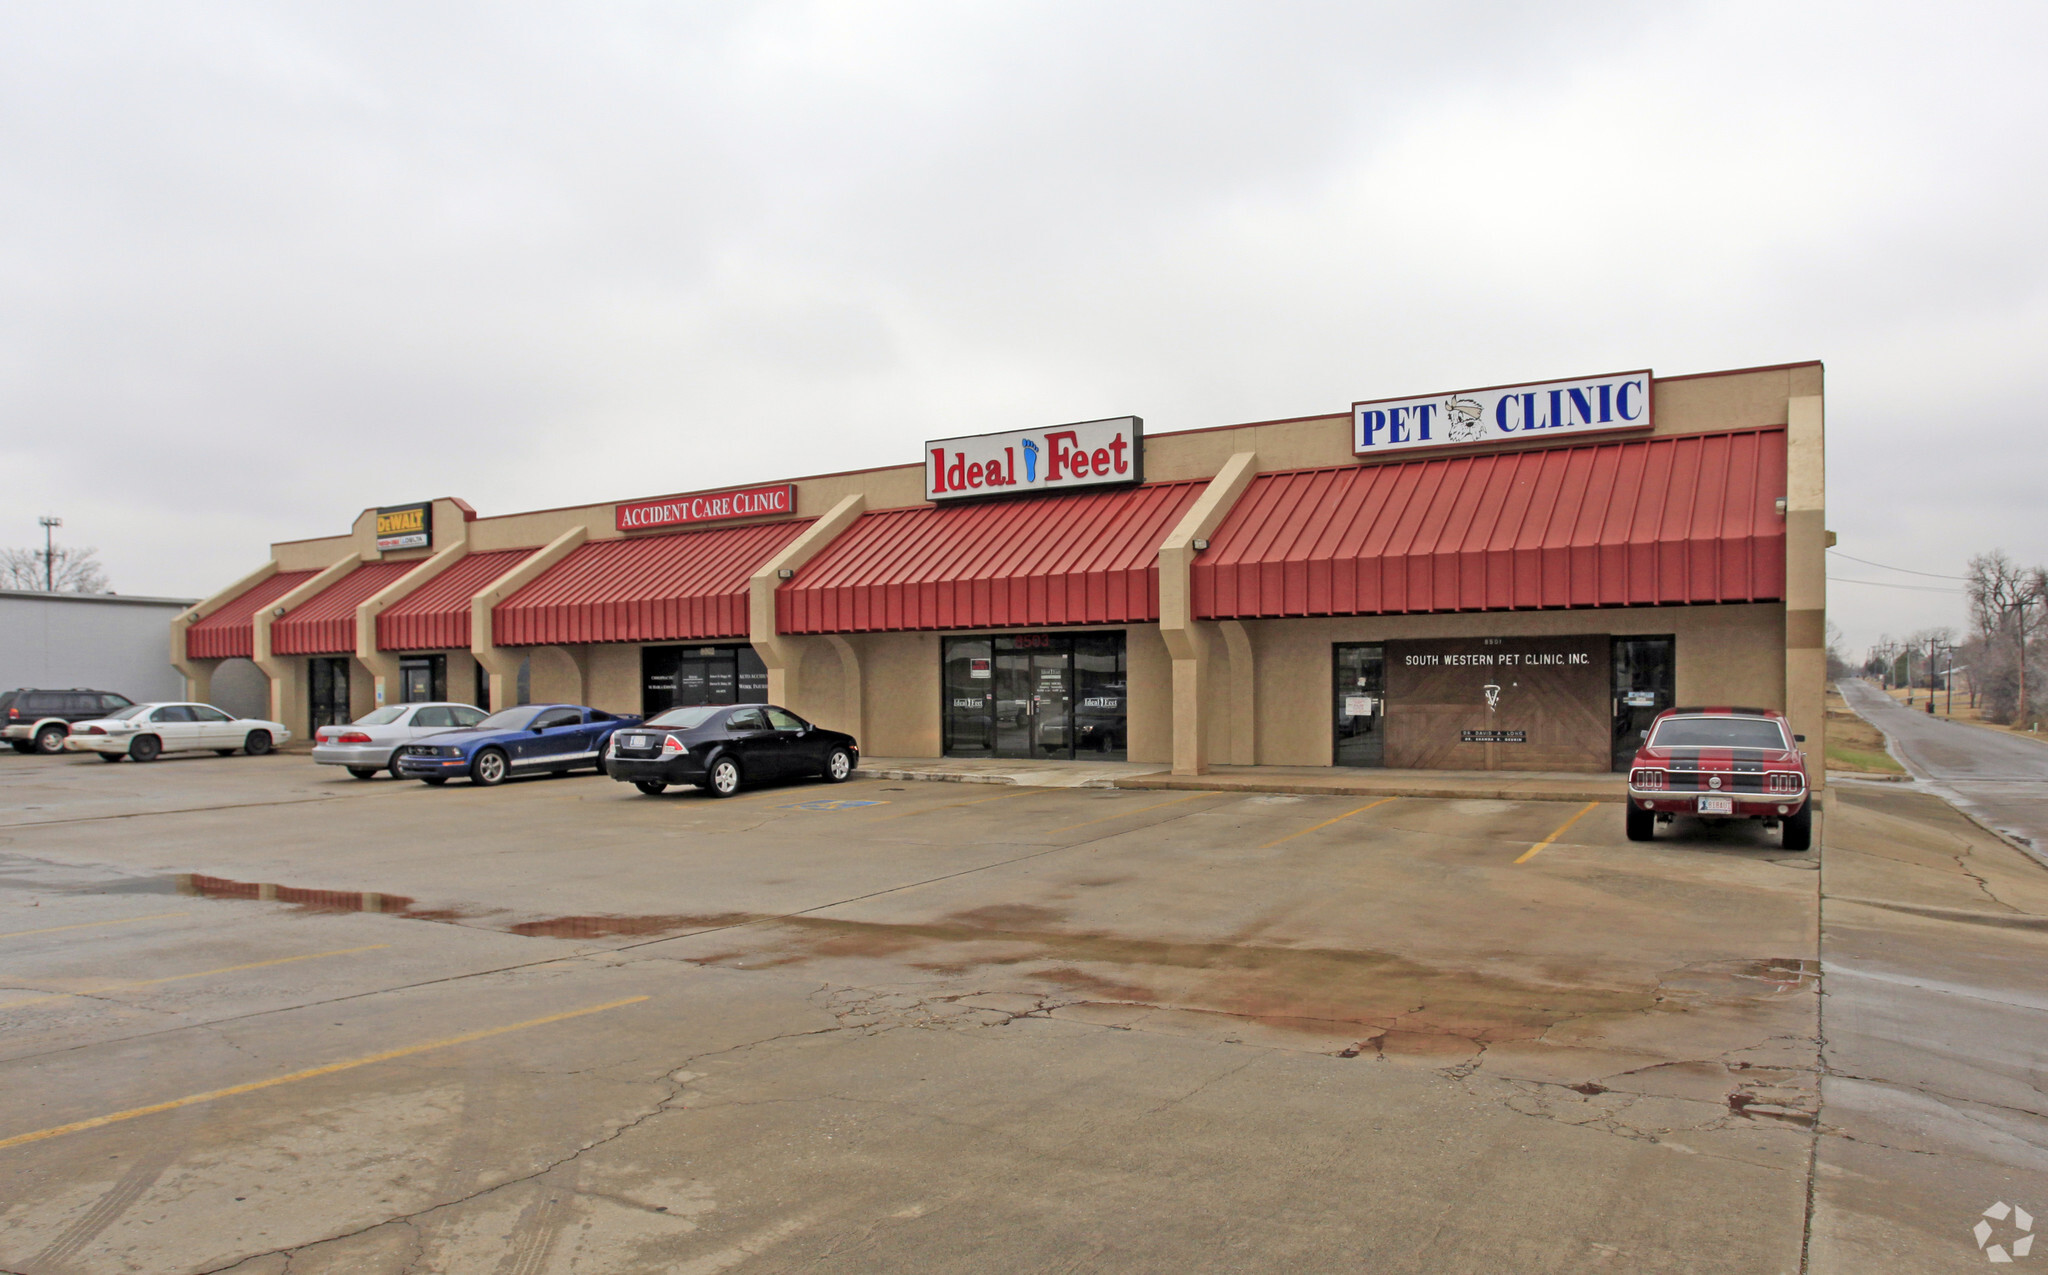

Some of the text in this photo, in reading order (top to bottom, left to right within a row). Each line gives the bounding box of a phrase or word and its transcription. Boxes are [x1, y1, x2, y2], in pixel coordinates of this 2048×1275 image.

[1361, 380, 1642, 446] PET CLINIC
[930, 430, 1128, 493] Ideal Feet
[622, 491, 784, 526] ACCIDENT CARE CLINIC
[1015, 634, 1048, 648] 8503
[1406, 655, 1439, 666] SOUTH
[1444, 654, 1494, 665] WESTERN
[1498, 654, 1520, 665] PET
[1569, 653, 1590, 664] INC.
